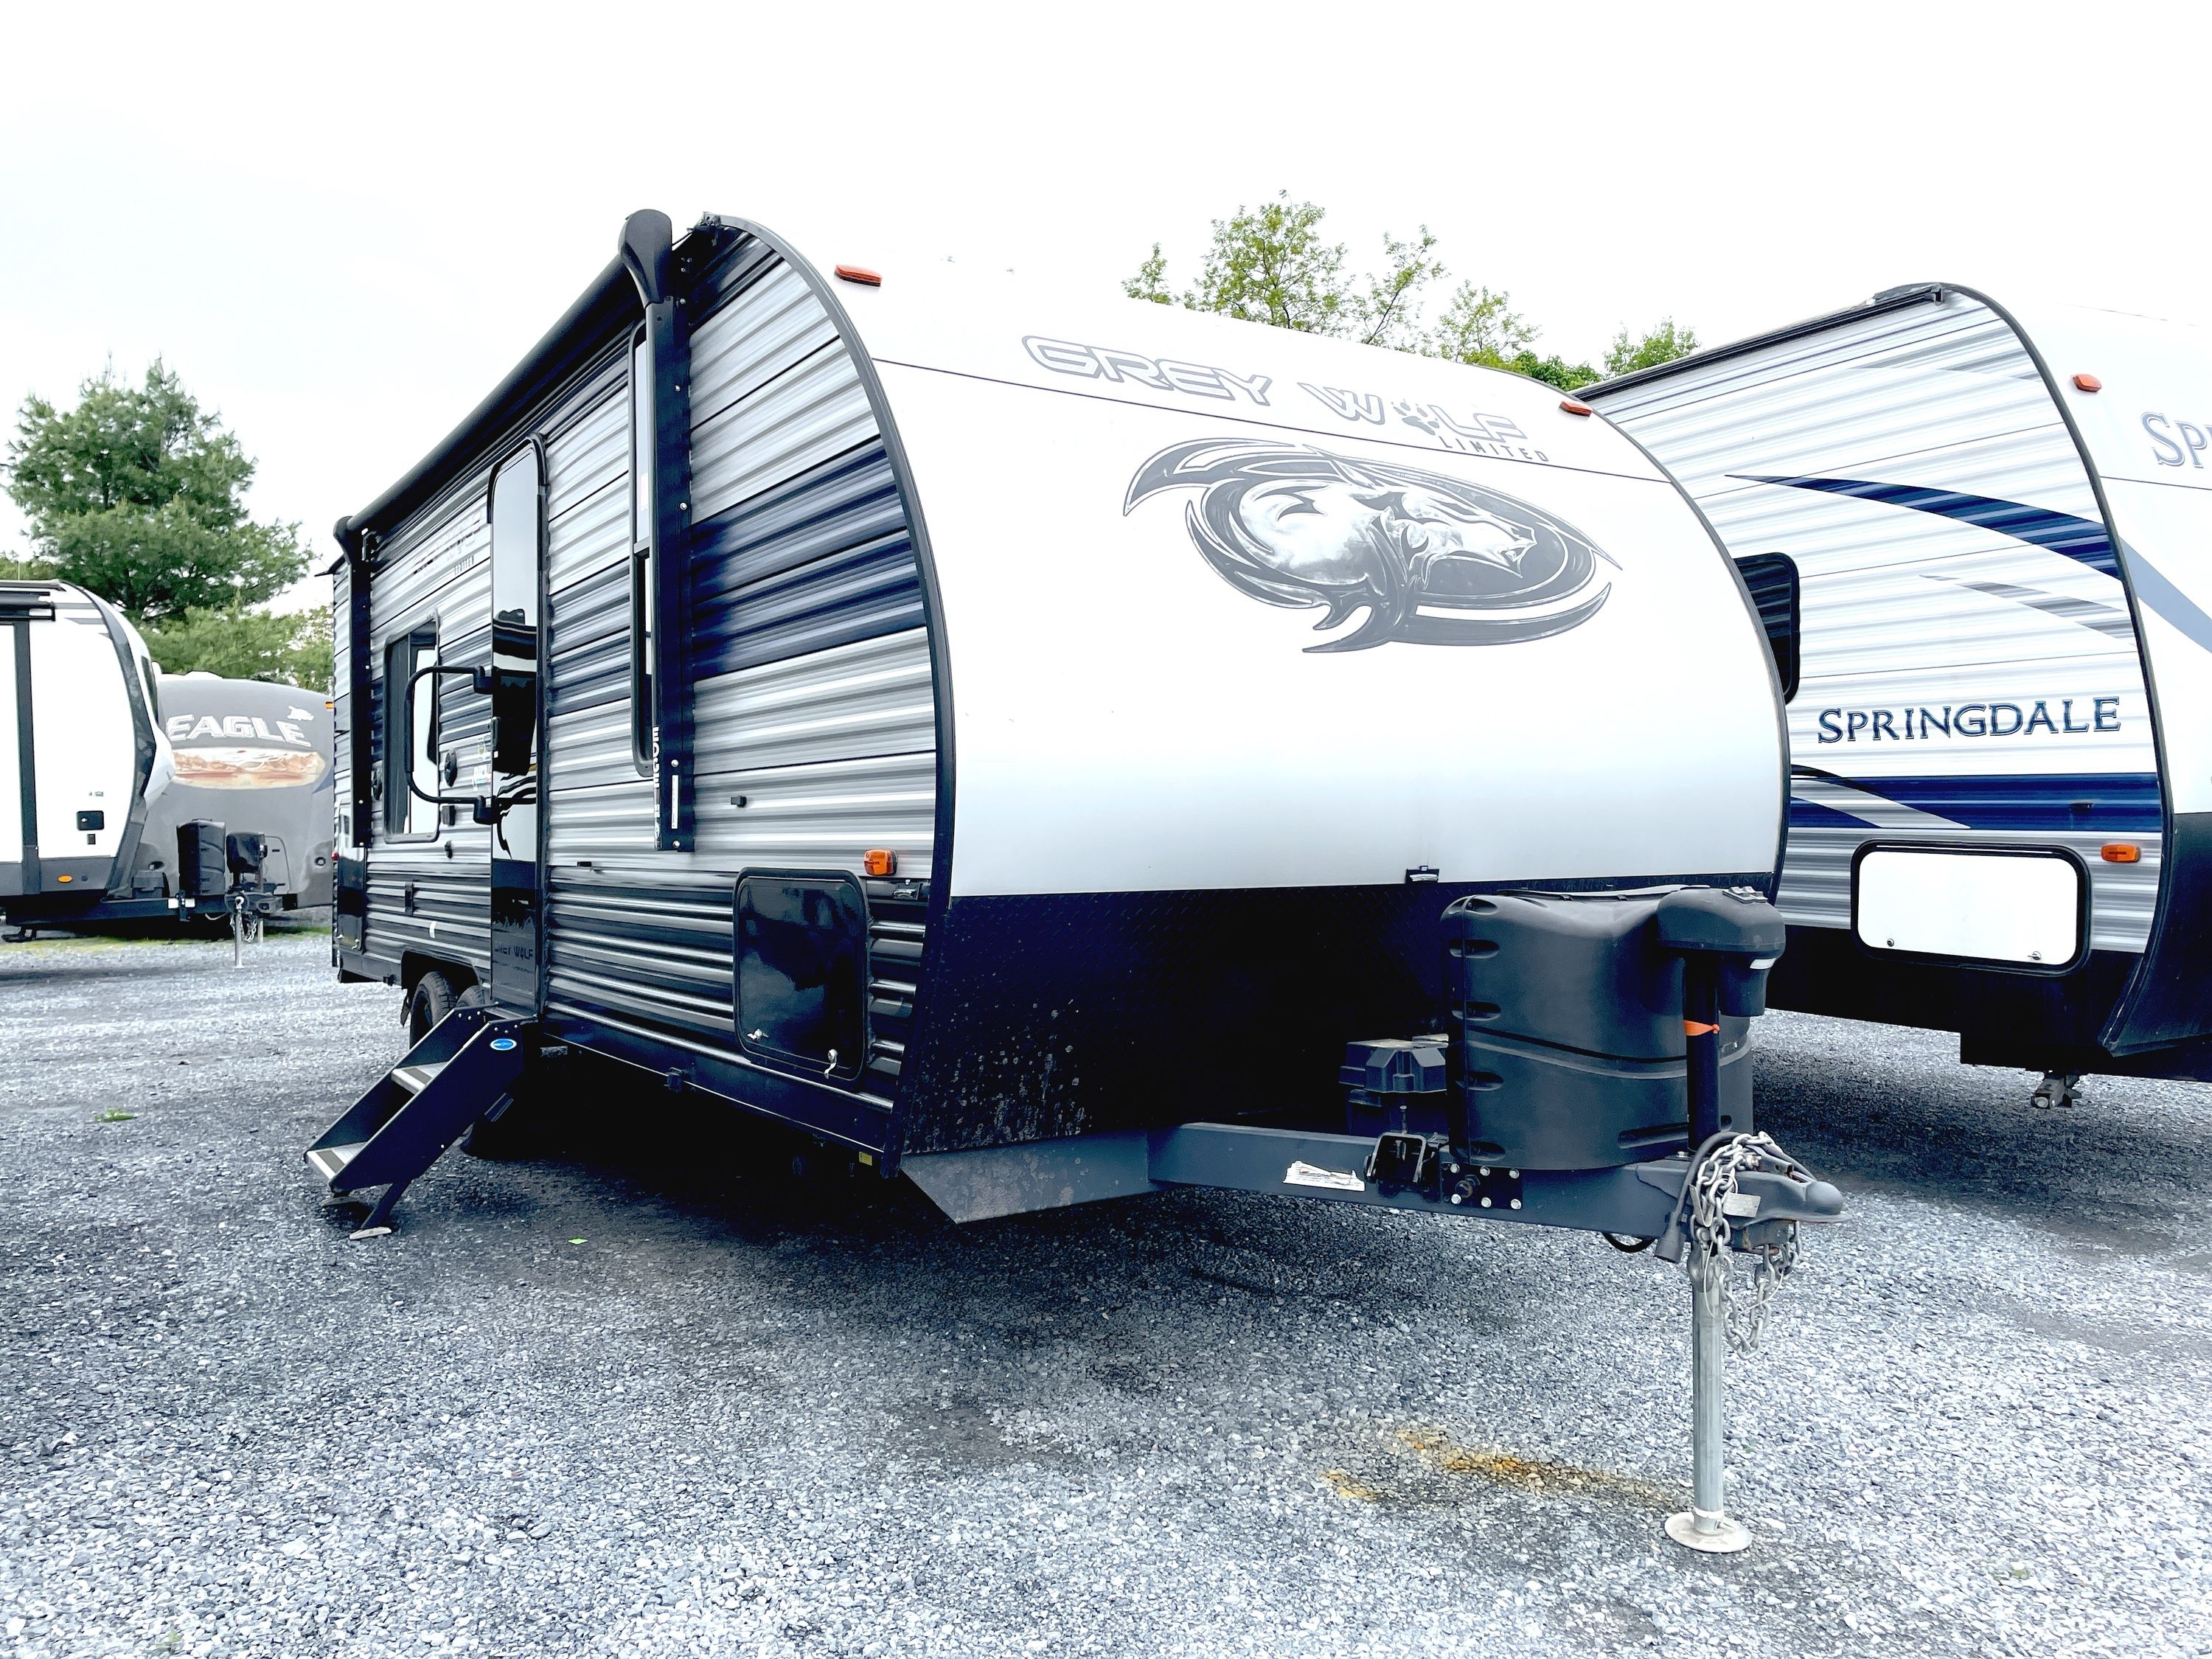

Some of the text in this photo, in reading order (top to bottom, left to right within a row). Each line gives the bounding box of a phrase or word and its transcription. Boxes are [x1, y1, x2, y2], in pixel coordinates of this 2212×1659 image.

[1022, 335, 1273, 406] GREY
[1439, 436, 1549, 462] LIMITED
[2140, 411, 2212, 469] SP
[167, 714, 311, 747] EAGLE
[1818, 696, 2121, 743] SPRINGDALE
[652, 726, 661, 788] EDGE
